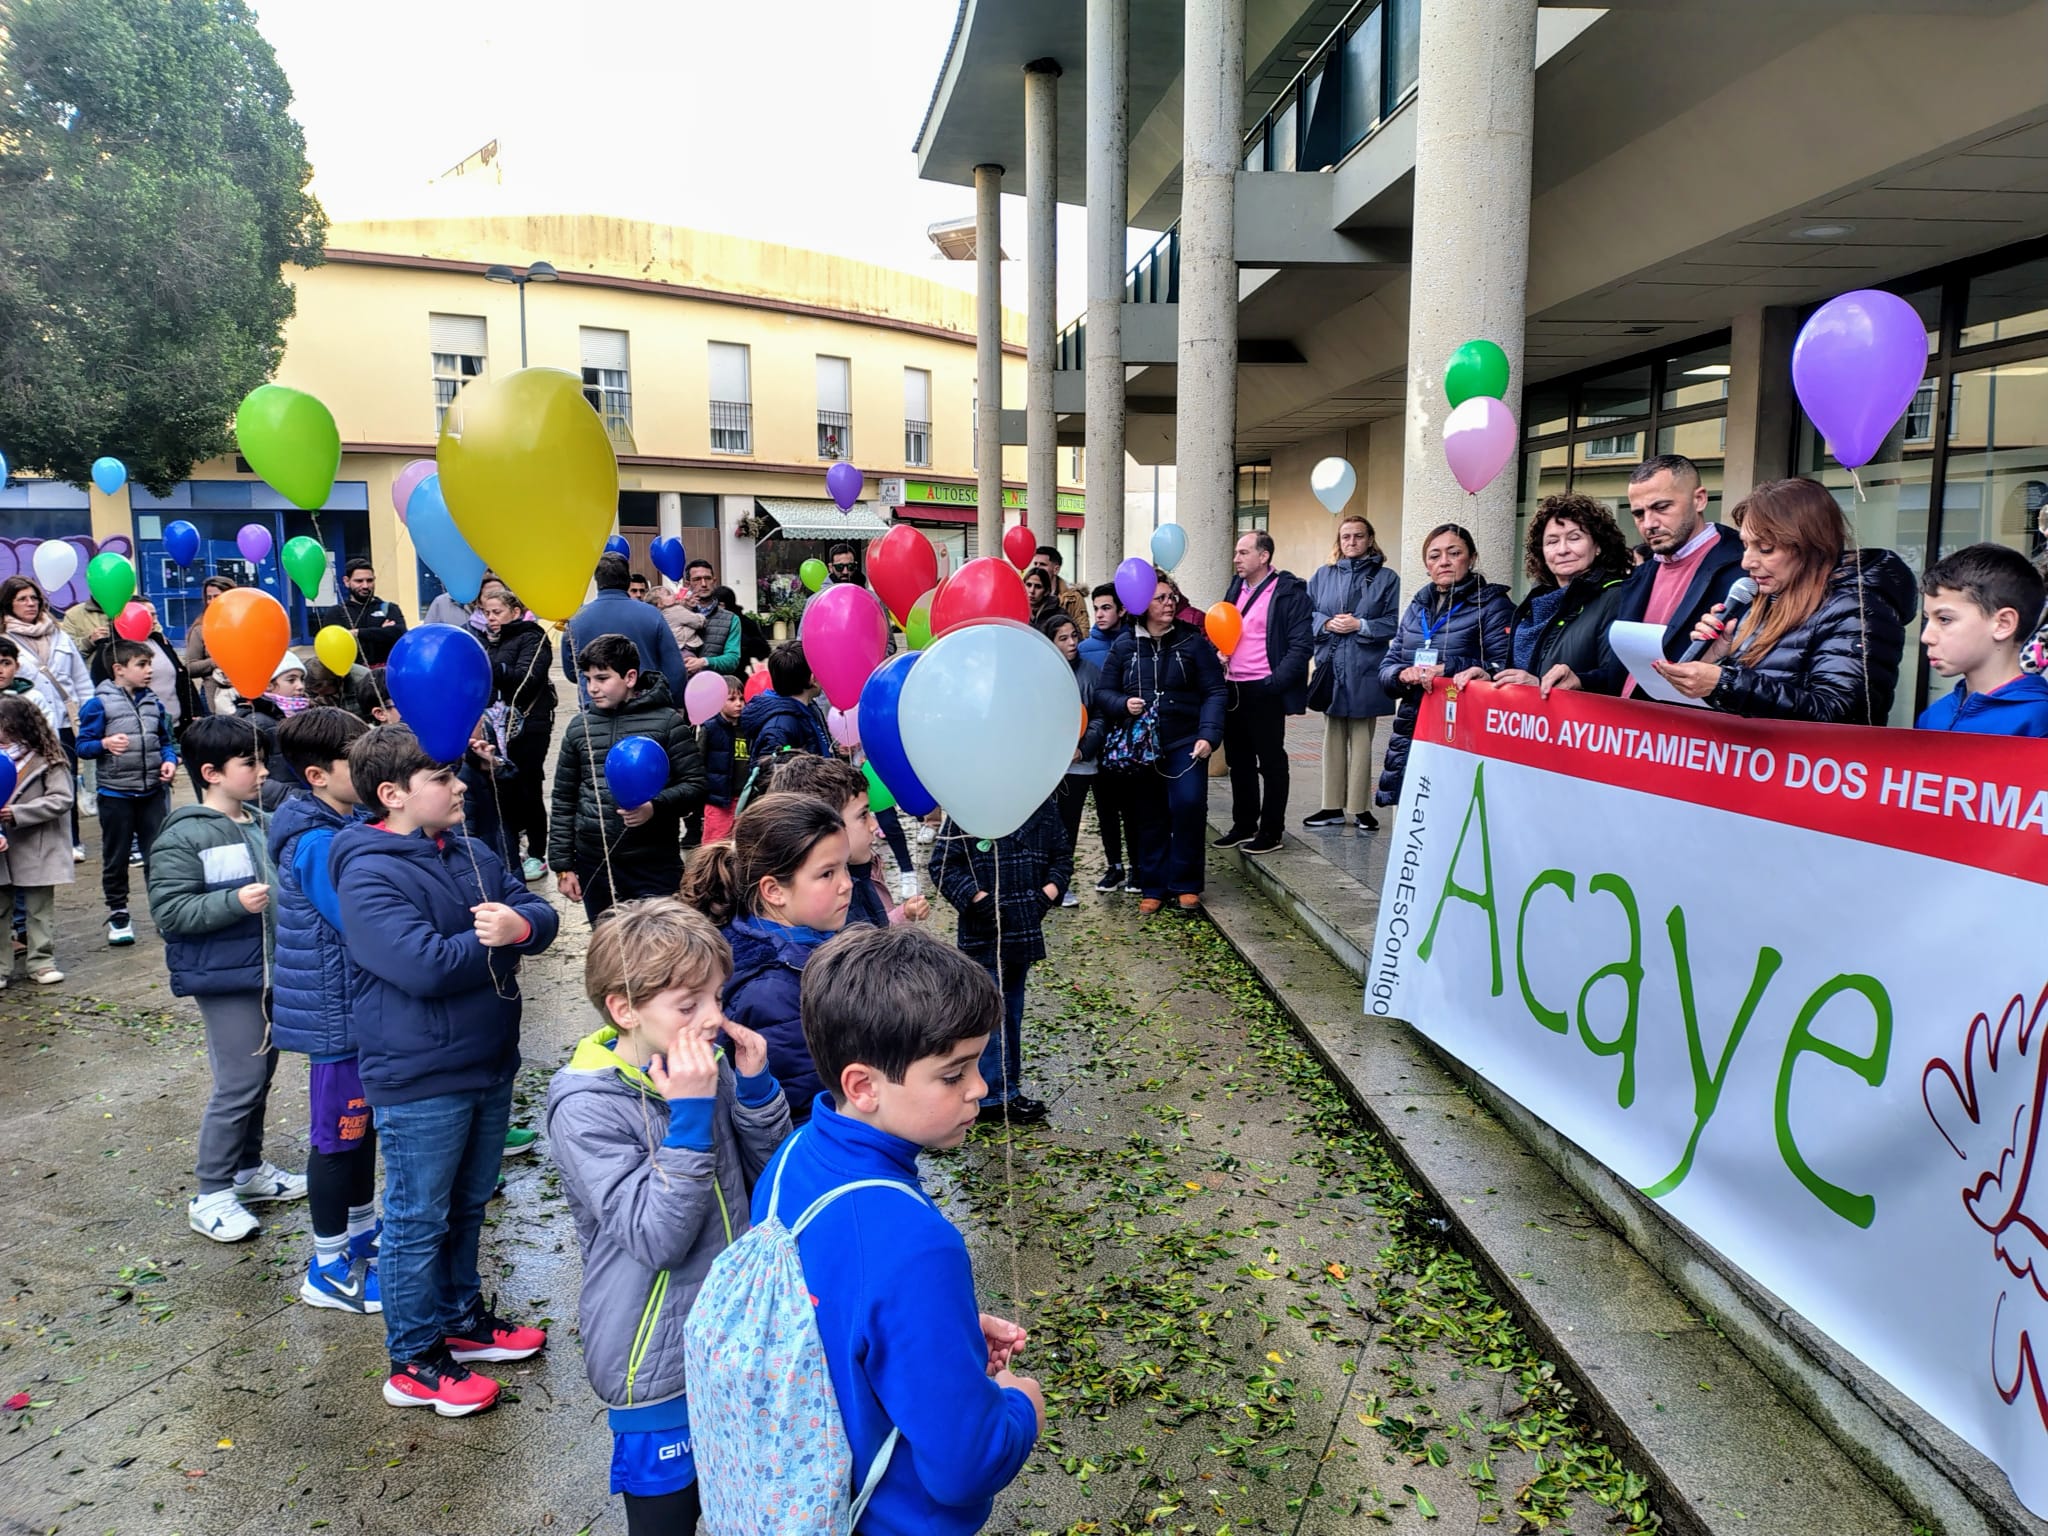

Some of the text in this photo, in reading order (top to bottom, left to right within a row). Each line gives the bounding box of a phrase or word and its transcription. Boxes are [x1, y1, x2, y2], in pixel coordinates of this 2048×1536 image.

[1486, 708, 2048, 836] EXCMO. AYUNTAMIENTO DOS HERMA
[1372, 775, 1431, 1015] #LaVidaEsContigo
[1417, 761, 1893, 1229] Acaye
